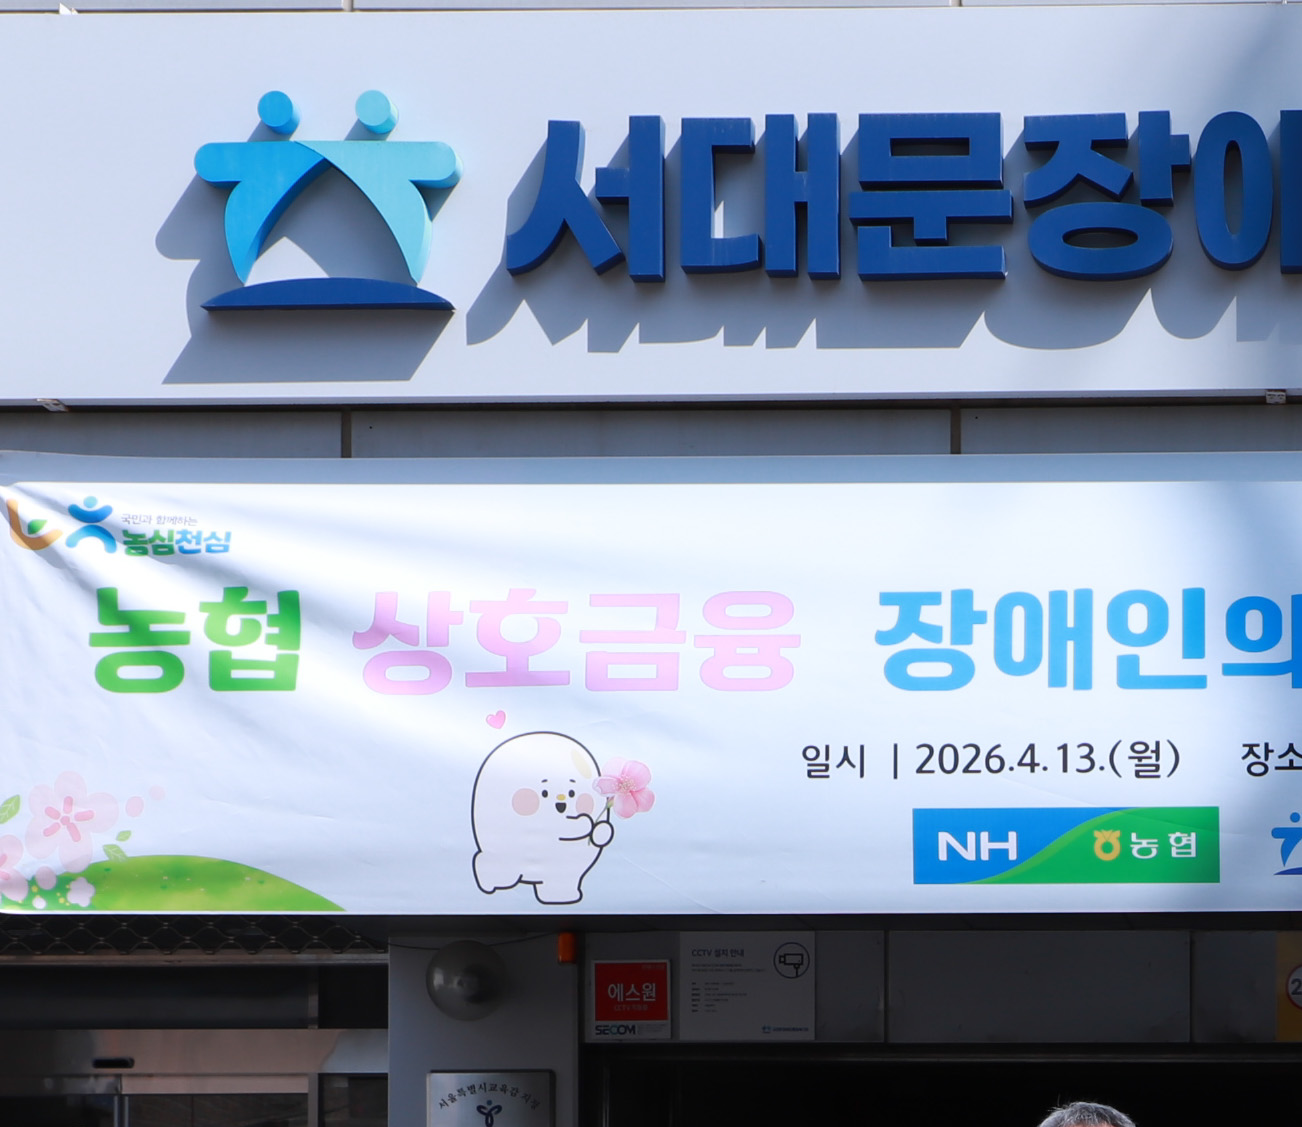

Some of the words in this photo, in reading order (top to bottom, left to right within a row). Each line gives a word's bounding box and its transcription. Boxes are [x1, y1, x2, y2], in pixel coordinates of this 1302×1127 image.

[120, 514, 151, 525] 국민과
[156, 515, 198, 526] 함께하는
[122, 529, 231, 557] 농심천심
[88, 586, 302, 694] 농협
[351, 588, 802, 697] 상호금융
[800, 742, 866, 779] 일시
[914, 741, 1183, 779] 2026.4.13.(월)
[937, 830, 1018, 861] NH
[1130, 830, 1198, 860] 농협
[691, 949, 712, 958] CCTV
[608, 982, 656, 1002] 에스원
[595, 1025, 636, 1035] SECOM
